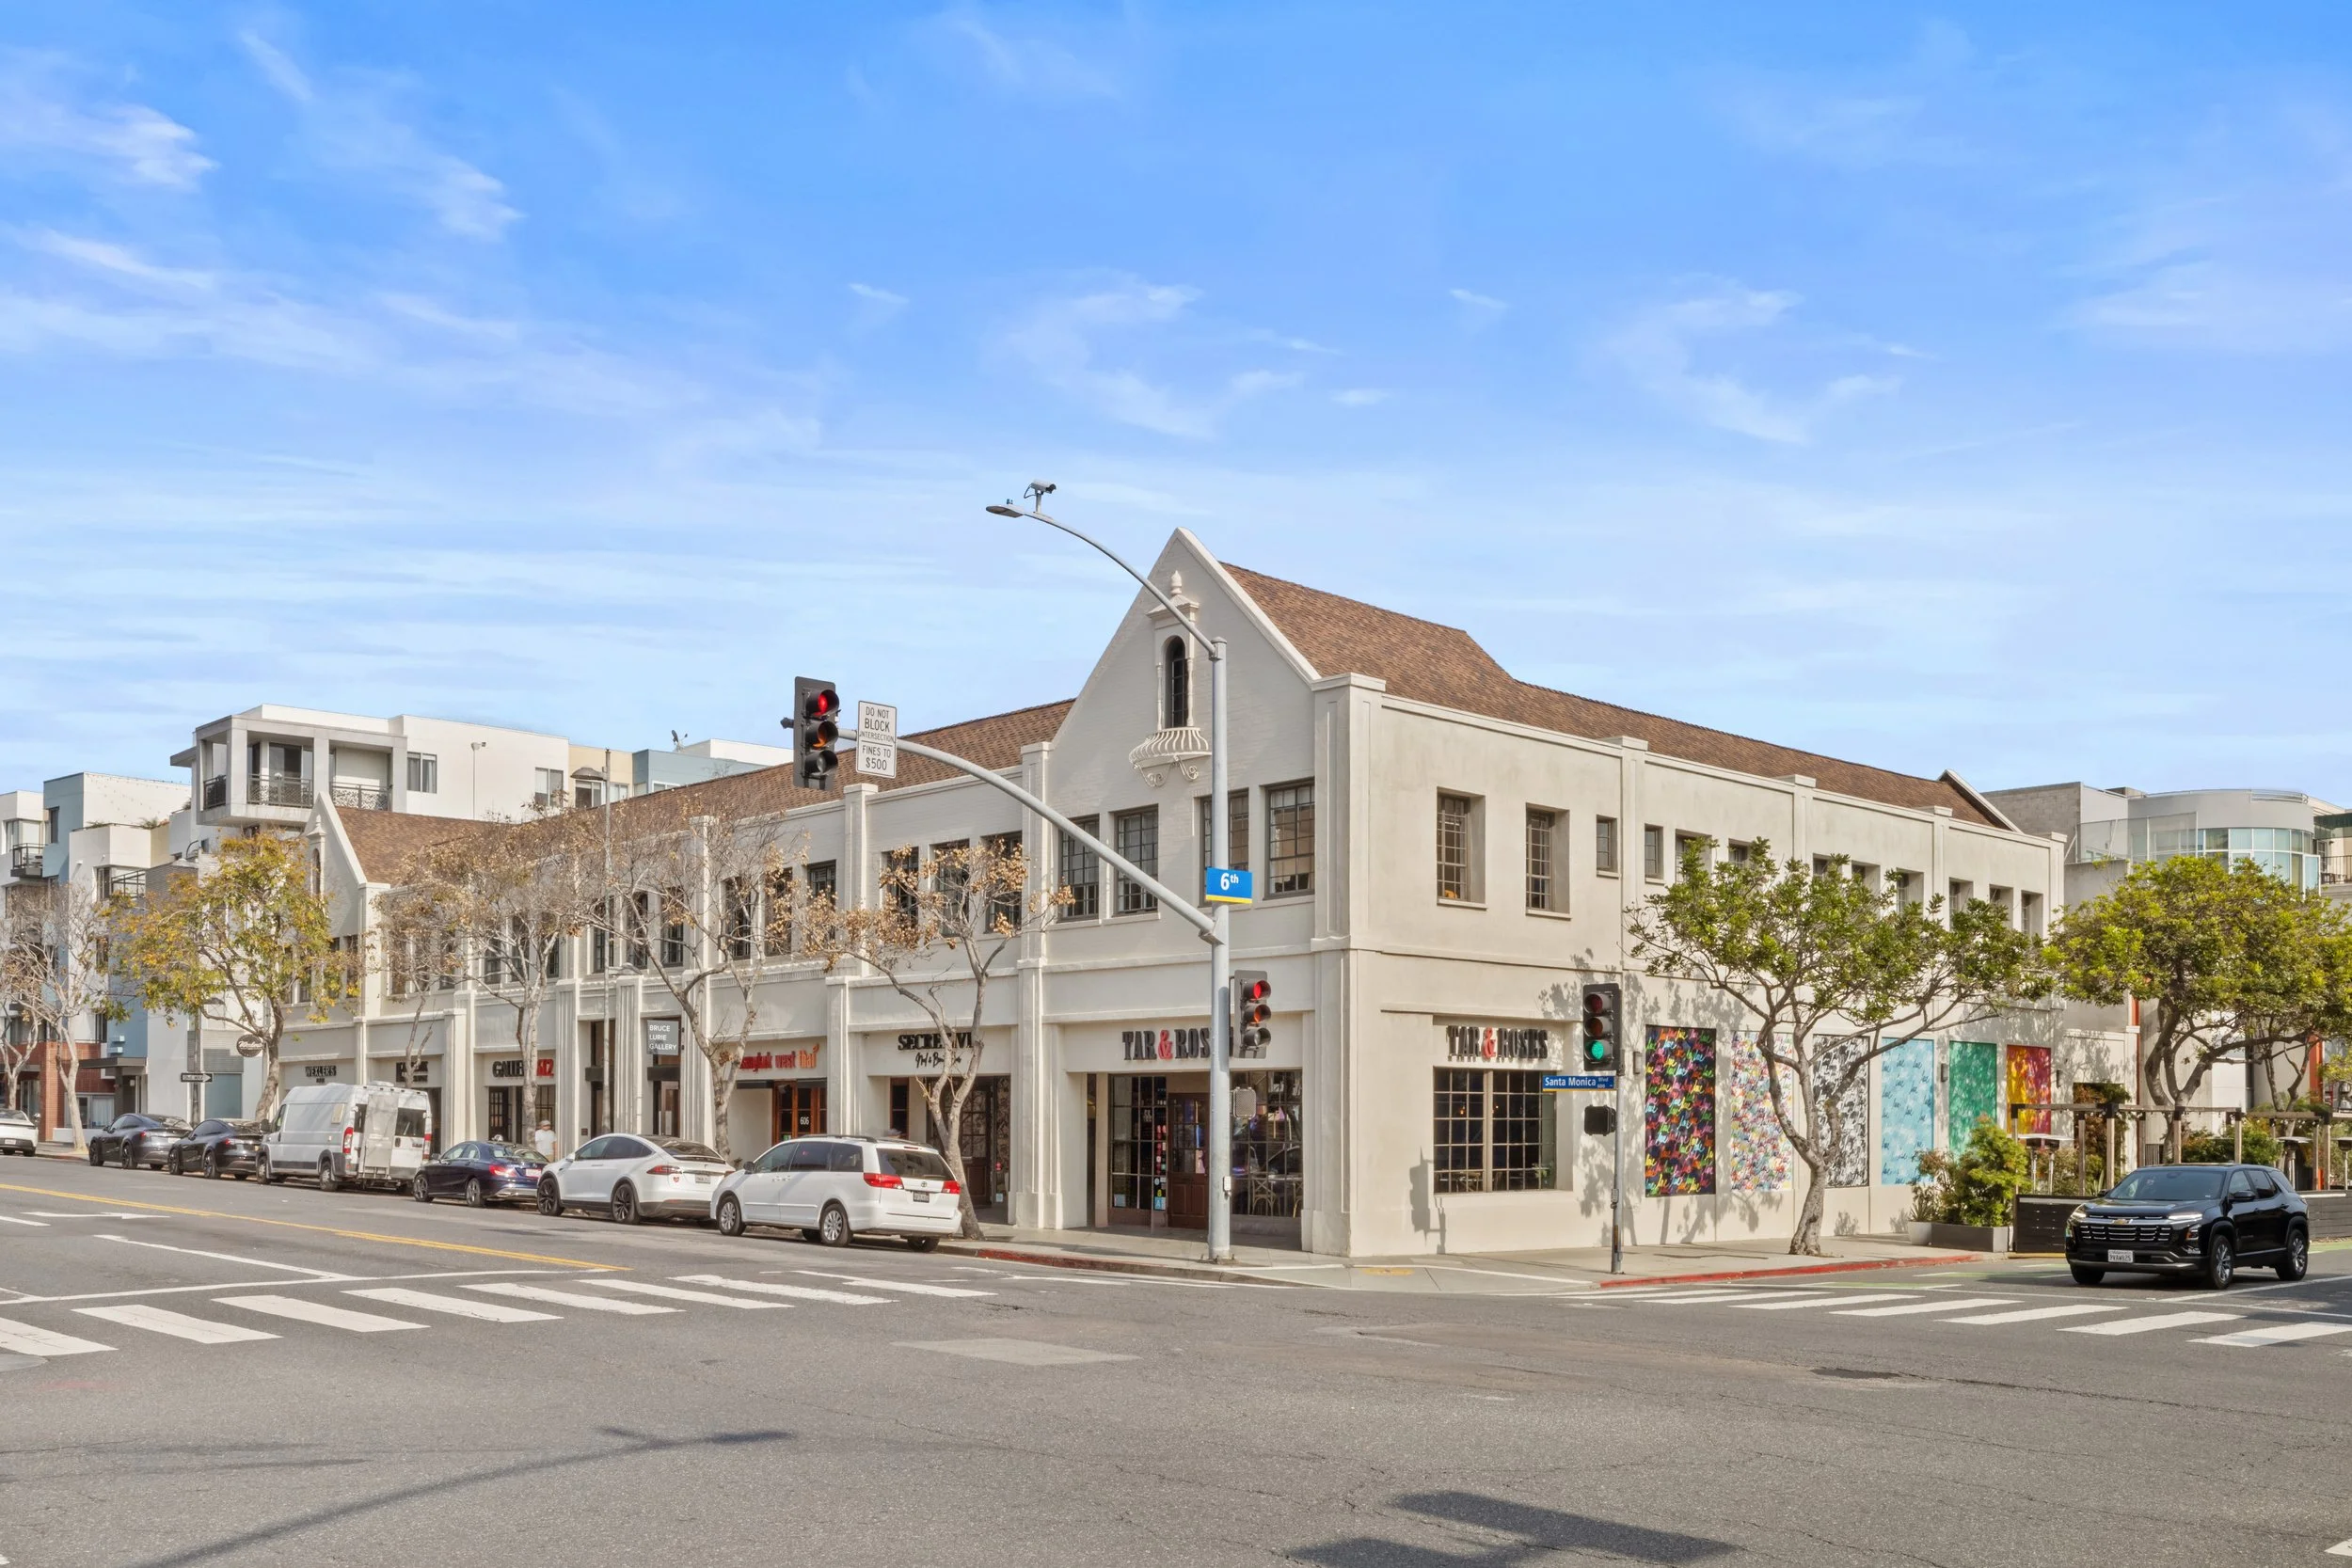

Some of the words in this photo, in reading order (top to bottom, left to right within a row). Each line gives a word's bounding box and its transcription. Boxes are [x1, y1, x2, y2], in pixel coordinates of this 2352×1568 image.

[866, 706, 875, 717] DO
[877, 709, 890, 720] NOT
[865, 718, 890, 733] BLOCK
[859, 731, 895, 743] INTERSECTION
[862, 745, 882, 757] FINES
[883, 748, 892, 758] TO
[865, 757, 887, 770] $500
[1220, 872, 1239, 891] 6th
[1122, 1031, 1157, 1060] TAR
[1157, 1029, 1173, 1060] &
[1446, 1025, 1480, 1057] TAR
[1481, 1026, 1496, 1059] &
[1497, 1027, 1549, 1060] ROSES
[775, 1051, 796, 1069] west
[799, 1043, 819, 1069] thai
[1545, 1077, 1566, 1086] Santa
[1568, 1077, 1597, 1086] Monica
[800, 1117, 810, 1126] 606
